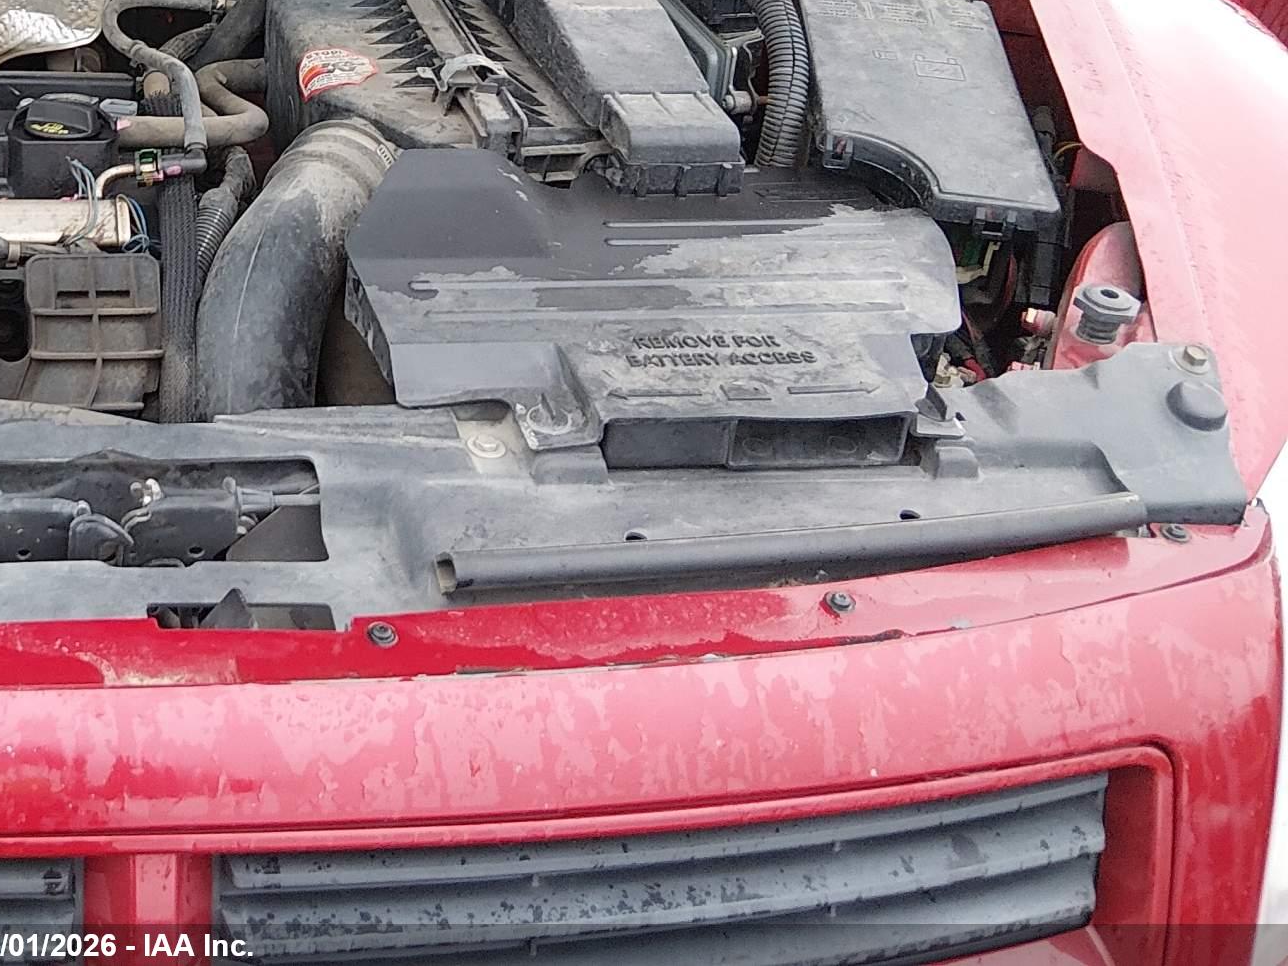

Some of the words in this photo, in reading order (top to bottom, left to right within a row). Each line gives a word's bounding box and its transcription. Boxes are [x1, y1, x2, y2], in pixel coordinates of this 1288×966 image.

[632, 333, 730, 350] REMOVE
[733, 333, 782, 349] FOR
[624, 351, 721, 369] BATTERY
[728, 350, 818, 367] ACCESS
